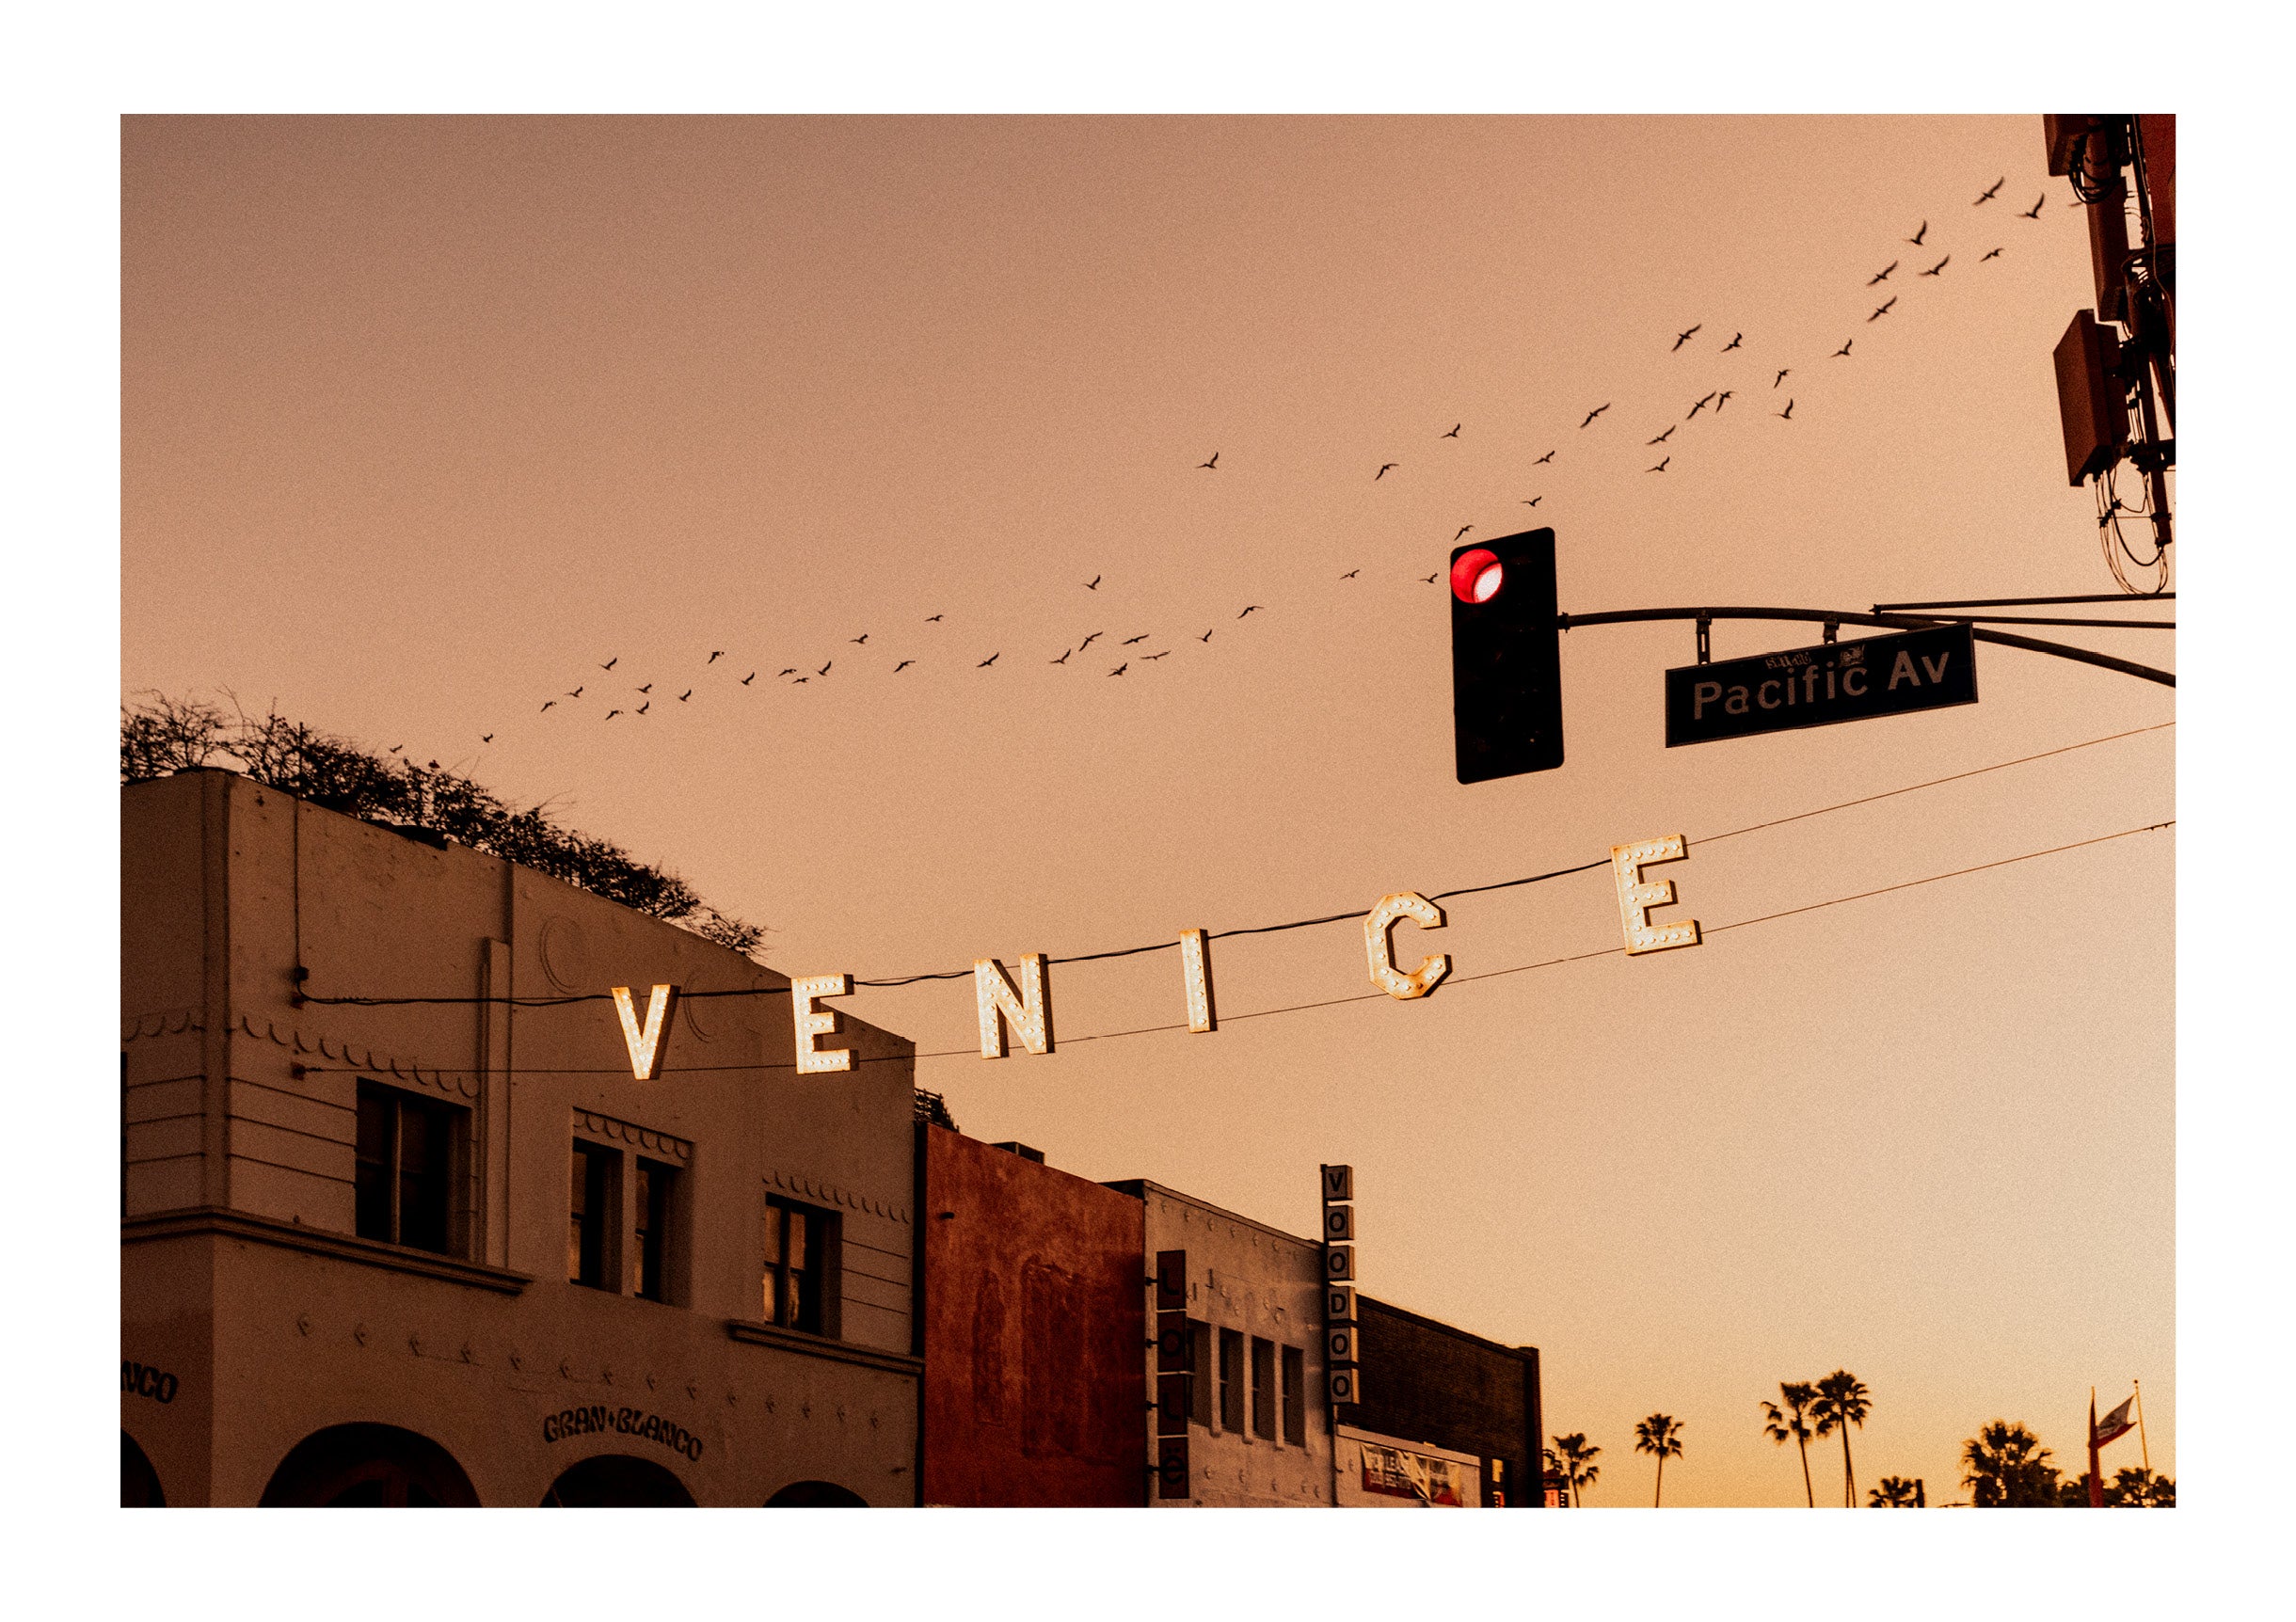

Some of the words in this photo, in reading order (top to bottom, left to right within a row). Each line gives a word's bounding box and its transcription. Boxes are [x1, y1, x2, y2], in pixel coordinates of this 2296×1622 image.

[1693, 661, 1868, 721] Pacific
[1887, 650, 1950, 691] Av
[611, 834, 1700, 1080] VENICE
[1328, 1172, 1350, 1397] VOODOO
[544, 1406, 607, 1443] GRAN
[616, 1407, 704, 1462] BLANCO
